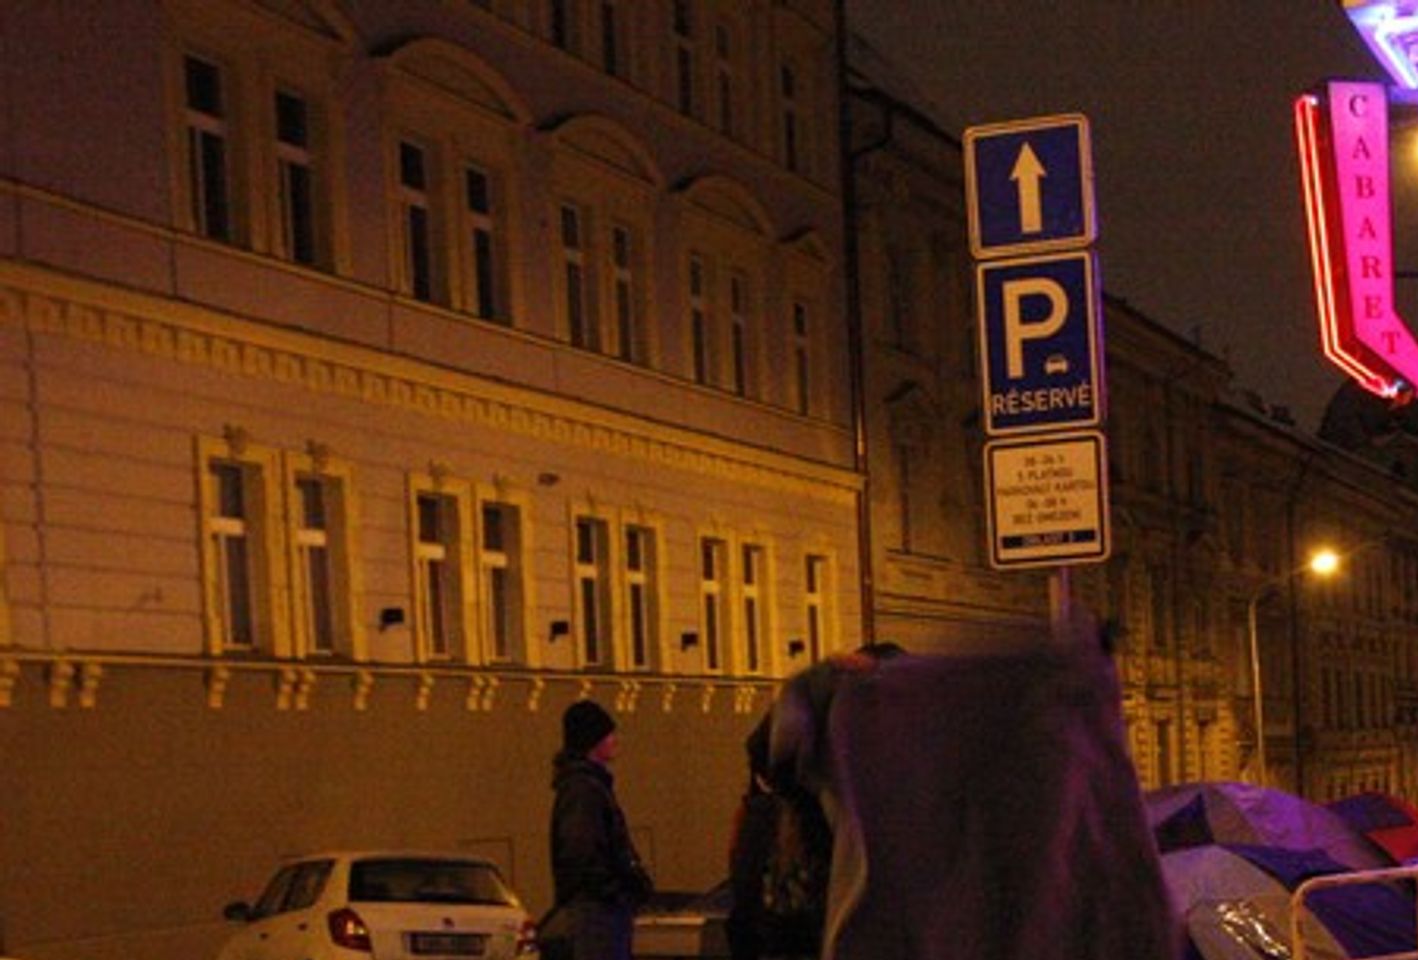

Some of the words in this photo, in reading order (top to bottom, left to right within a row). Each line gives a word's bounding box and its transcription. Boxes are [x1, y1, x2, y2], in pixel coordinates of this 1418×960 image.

[1348, 94, 1401, 354] CABARET
[1003, 277, 1069, 380] P
[991, 380, 1092, 416] RÉSERVÉ
